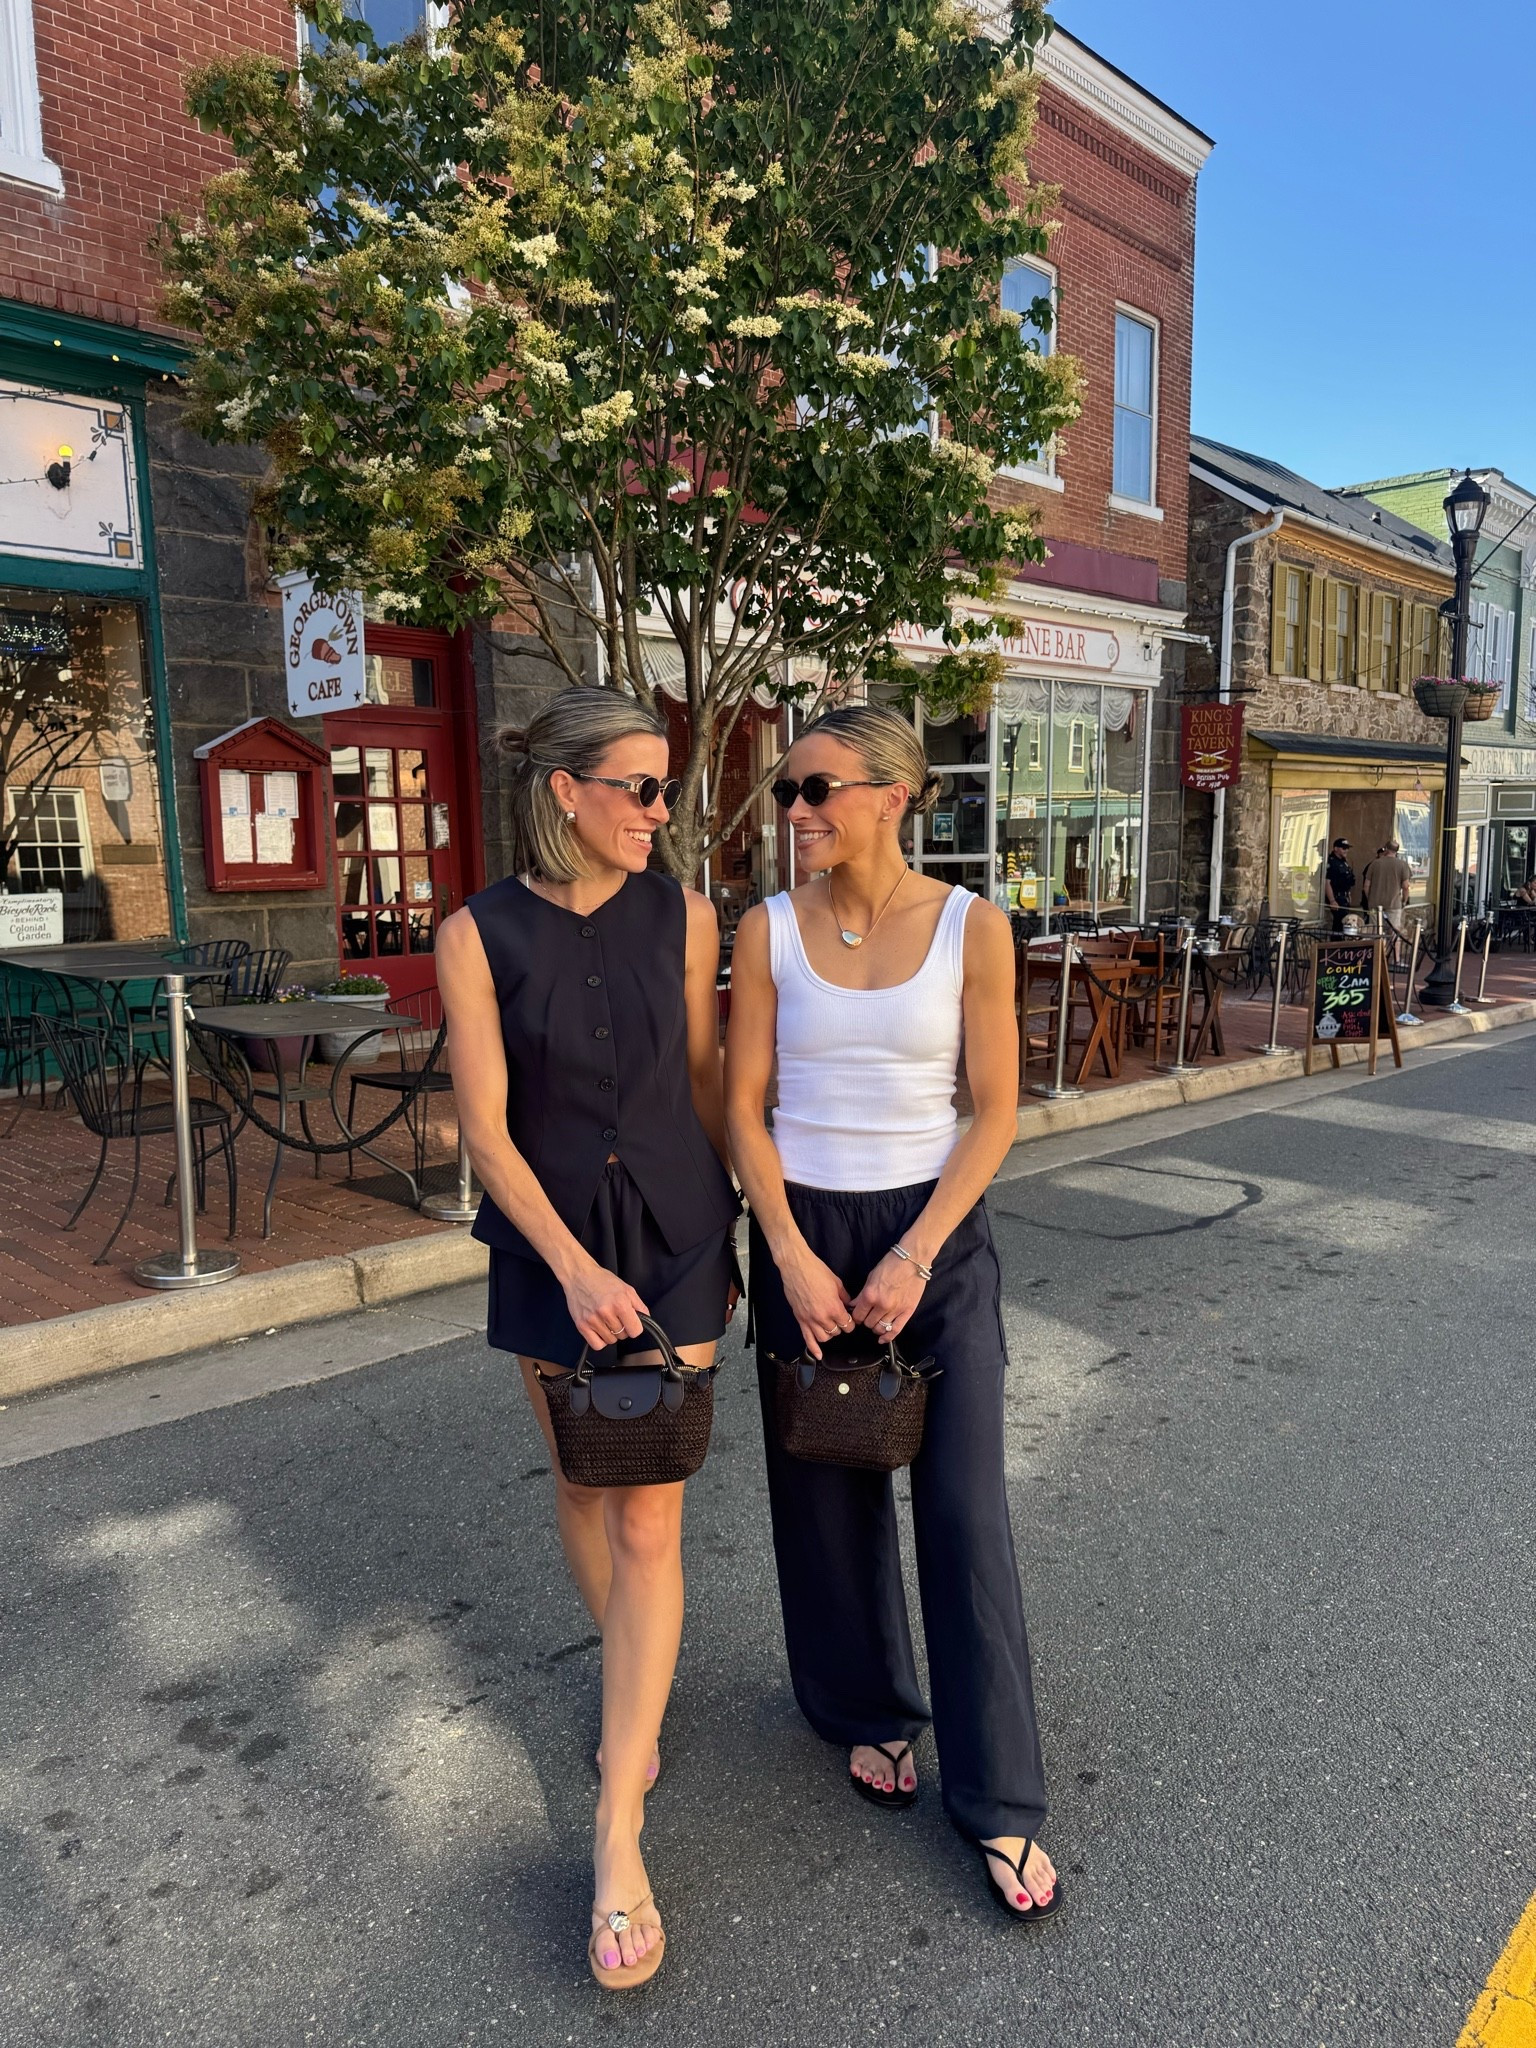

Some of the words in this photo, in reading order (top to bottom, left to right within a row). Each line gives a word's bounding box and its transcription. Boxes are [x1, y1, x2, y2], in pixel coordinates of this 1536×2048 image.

[289, 590, 359, 668] GEORGETOWN
[1001, 627, 1051, 656] WINE
[1054, 630, 1088, 664] BAR
[308, 677, 342, 701] CAFE
[1191, 708, 1233, 723] KING'S
[1190, 723, 1233, 736] COURT
[1186, 736, 1235, 750] TAVERN
[1472, 749, 1505, 775] GREEN
[1508, 751, 1531, 775] TREE
[10, 923, 46, 934] Colonial
[17, 931, 52, 942] Garden
[1320, 948, 1373, 966] Kings
[1326, 960, 1367, 974] court
[1322, 988, 1370, 1011] 365
